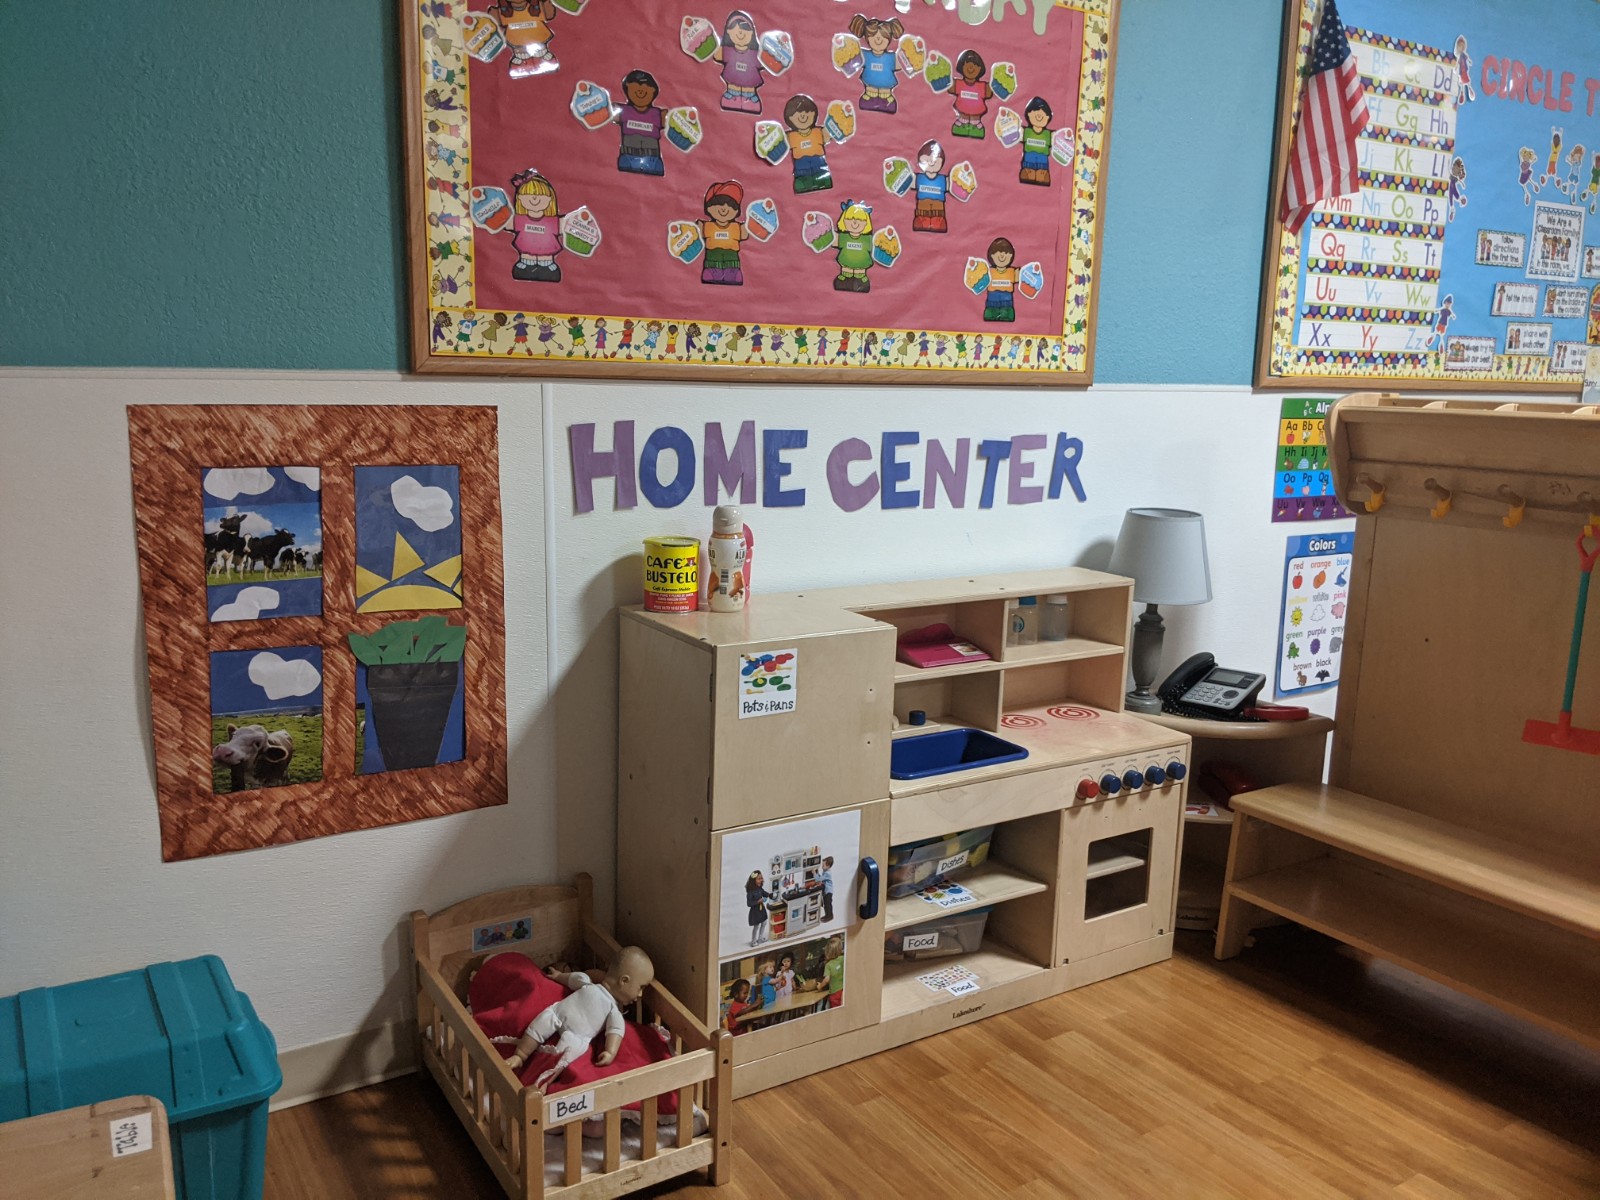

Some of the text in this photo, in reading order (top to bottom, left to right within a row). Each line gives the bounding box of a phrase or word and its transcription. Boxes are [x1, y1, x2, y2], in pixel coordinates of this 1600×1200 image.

[1433, 65, 1452, 92] Dd
[1481, 55, 1575, 112] CIRCLE
[628, 121, 653, 131] FEBRUARY
[1395, 103, 1418, 132] Gg
[1429, 109, 1449, 135] Hh
[1394, 147, 1413, 173] Kk
[1362, 191, 1381, 216] Nn
[1391, 194, 1413, 219] Oo
[1423, 198, 1439, 227] Pp
[1321, 232, 1436, 266] Qq Rr Ss Tt
[1316, 277, 1431, 307] Uu Vv Ww
[1308, 322, 1423, 353] Xx Yy Zz
[1285, 421, 1298, 431] Aa
[1302, 420, 1313, 431] Bb
[1284, 447, 1296, 457] Hh
[1300, 446, 1307, 457] Ii
[1311, 446, 1318, 460] Jj
[570, 419, 1087, 514] HOME CENTER
[1283, 472, 1329, 485] Oo Pp Qq
[1309, 539, 1336, 552] Colors
[1293, 557, 1349, 571] red orange blue
[646, 569, 698, 584] BUSTELO
[1333, 590, 1346, 601] pink
[1285, 625, 1344, 642] green purple grey
[1293, 658, 1332, 671] brown black
[743, 699, 764, 714] Pots
[770, 700, 794, 712] Pans
[908, 936, 935, 948] Food
[951, 983, 974, 993] Food
[557, 1095, 587, 1117] Bed
